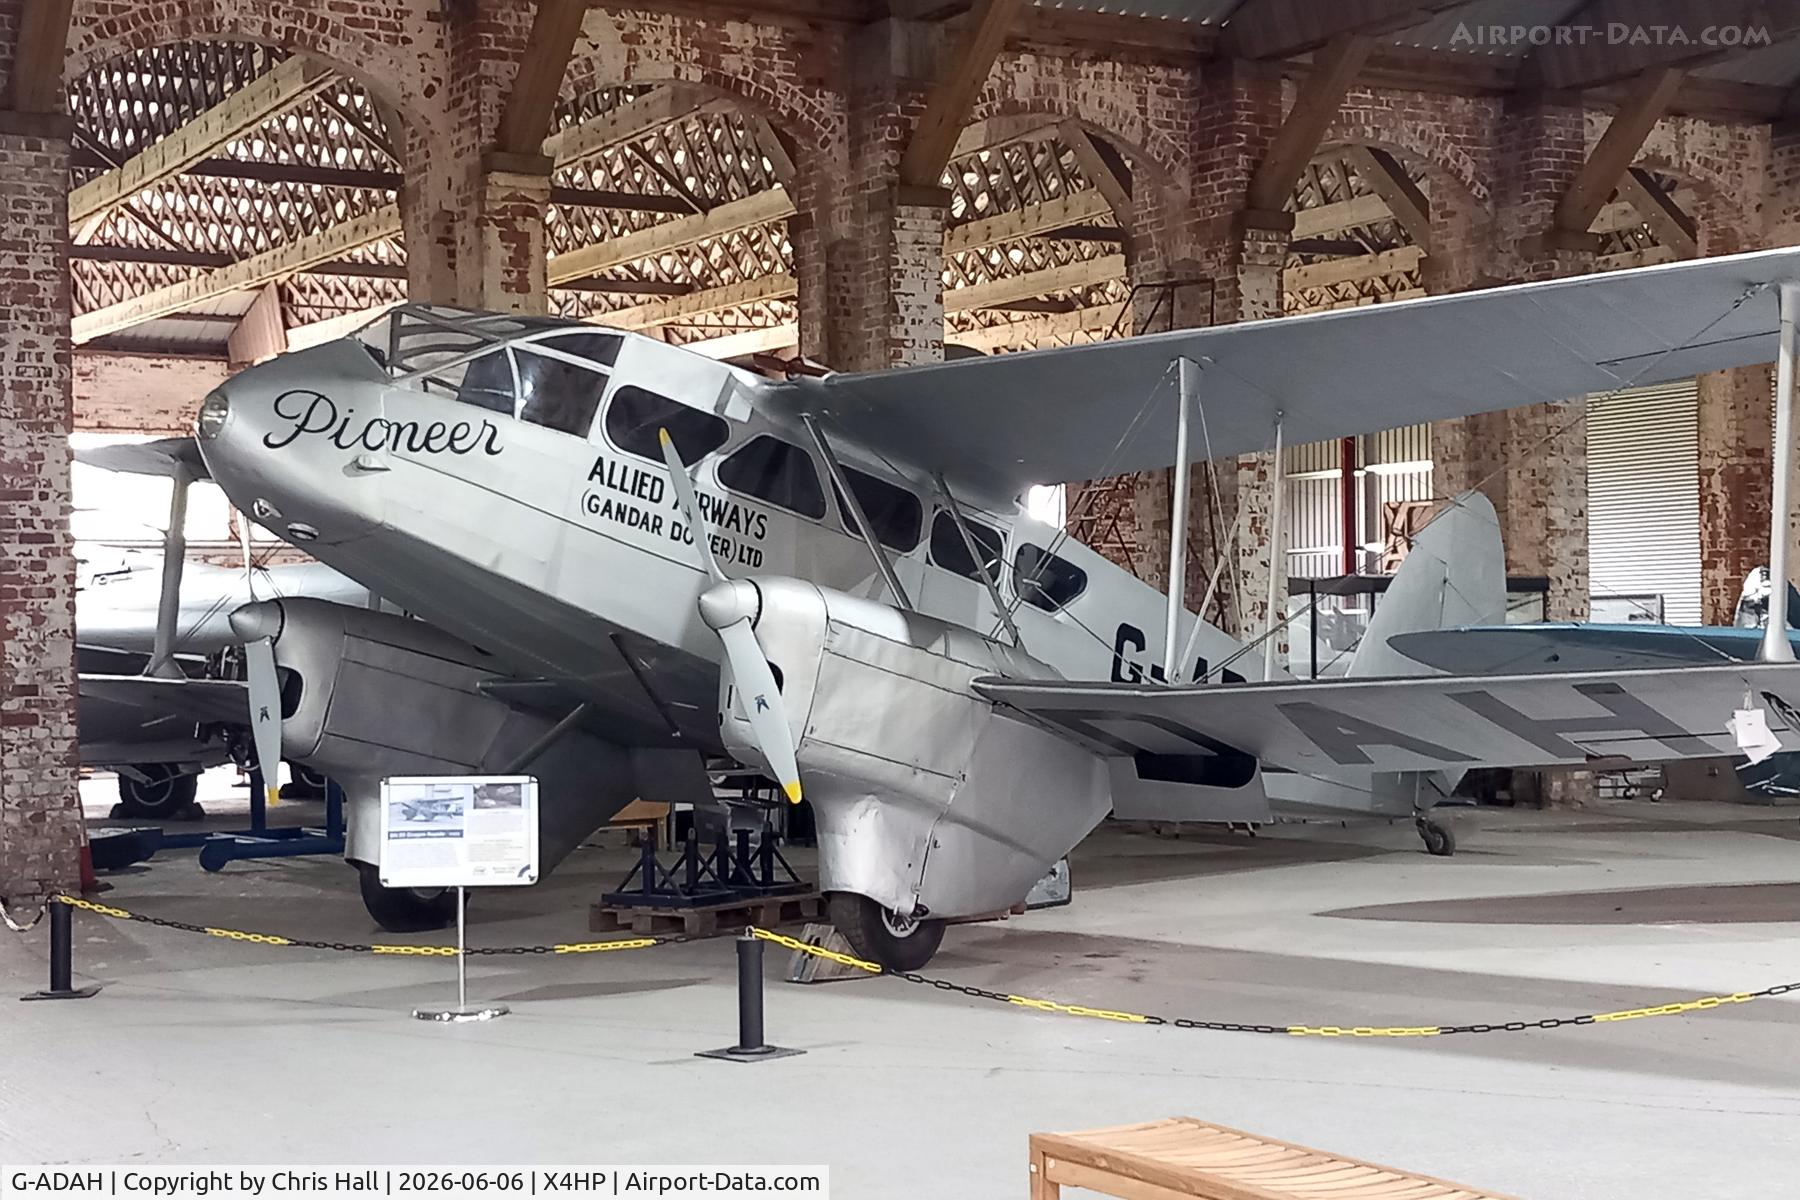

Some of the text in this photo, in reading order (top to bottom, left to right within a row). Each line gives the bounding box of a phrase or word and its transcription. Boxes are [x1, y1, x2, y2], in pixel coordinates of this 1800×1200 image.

[263, 390, 504, 456] Pioneer
[588, 456, 665, 504] ALLIED
[581, 488, 763, 568] (GANDAR DOER) LTD
